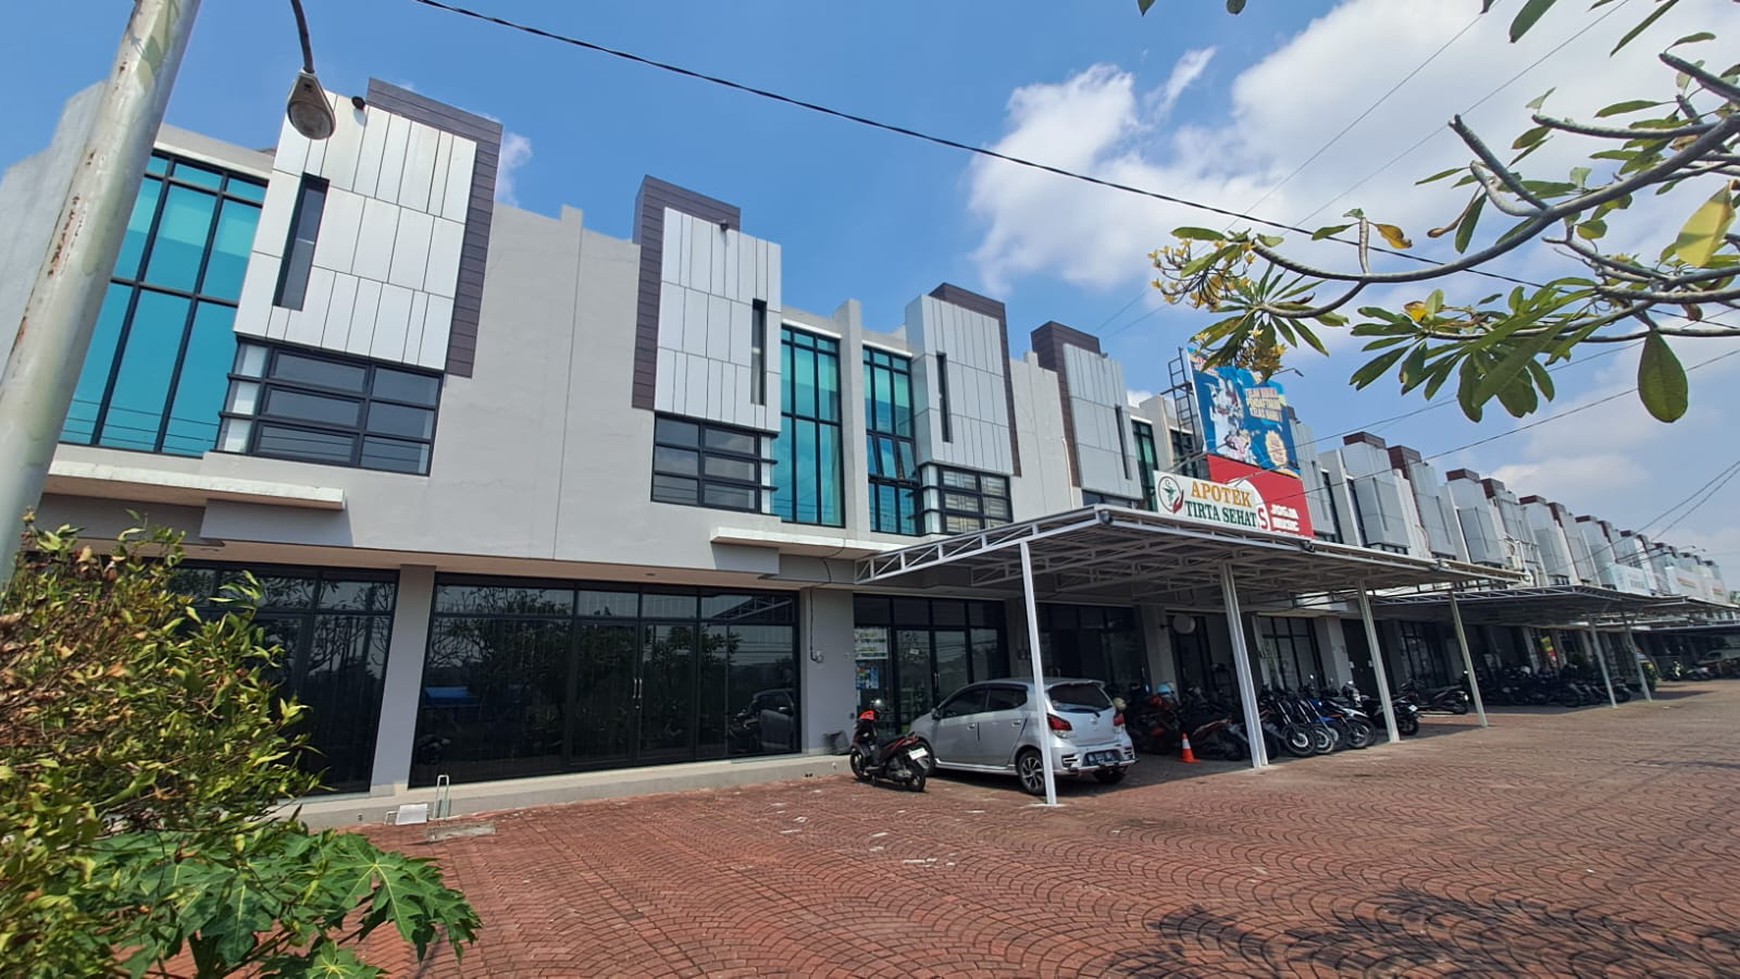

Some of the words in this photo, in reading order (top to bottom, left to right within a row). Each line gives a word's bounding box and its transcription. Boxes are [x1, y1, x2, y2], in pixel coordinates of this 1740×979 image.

[1191, 480, 1253, 508] APOTEK
[1185, 500, 1221, 522] TIRTA
[1222, 506, 1257, 528] SEHAT
